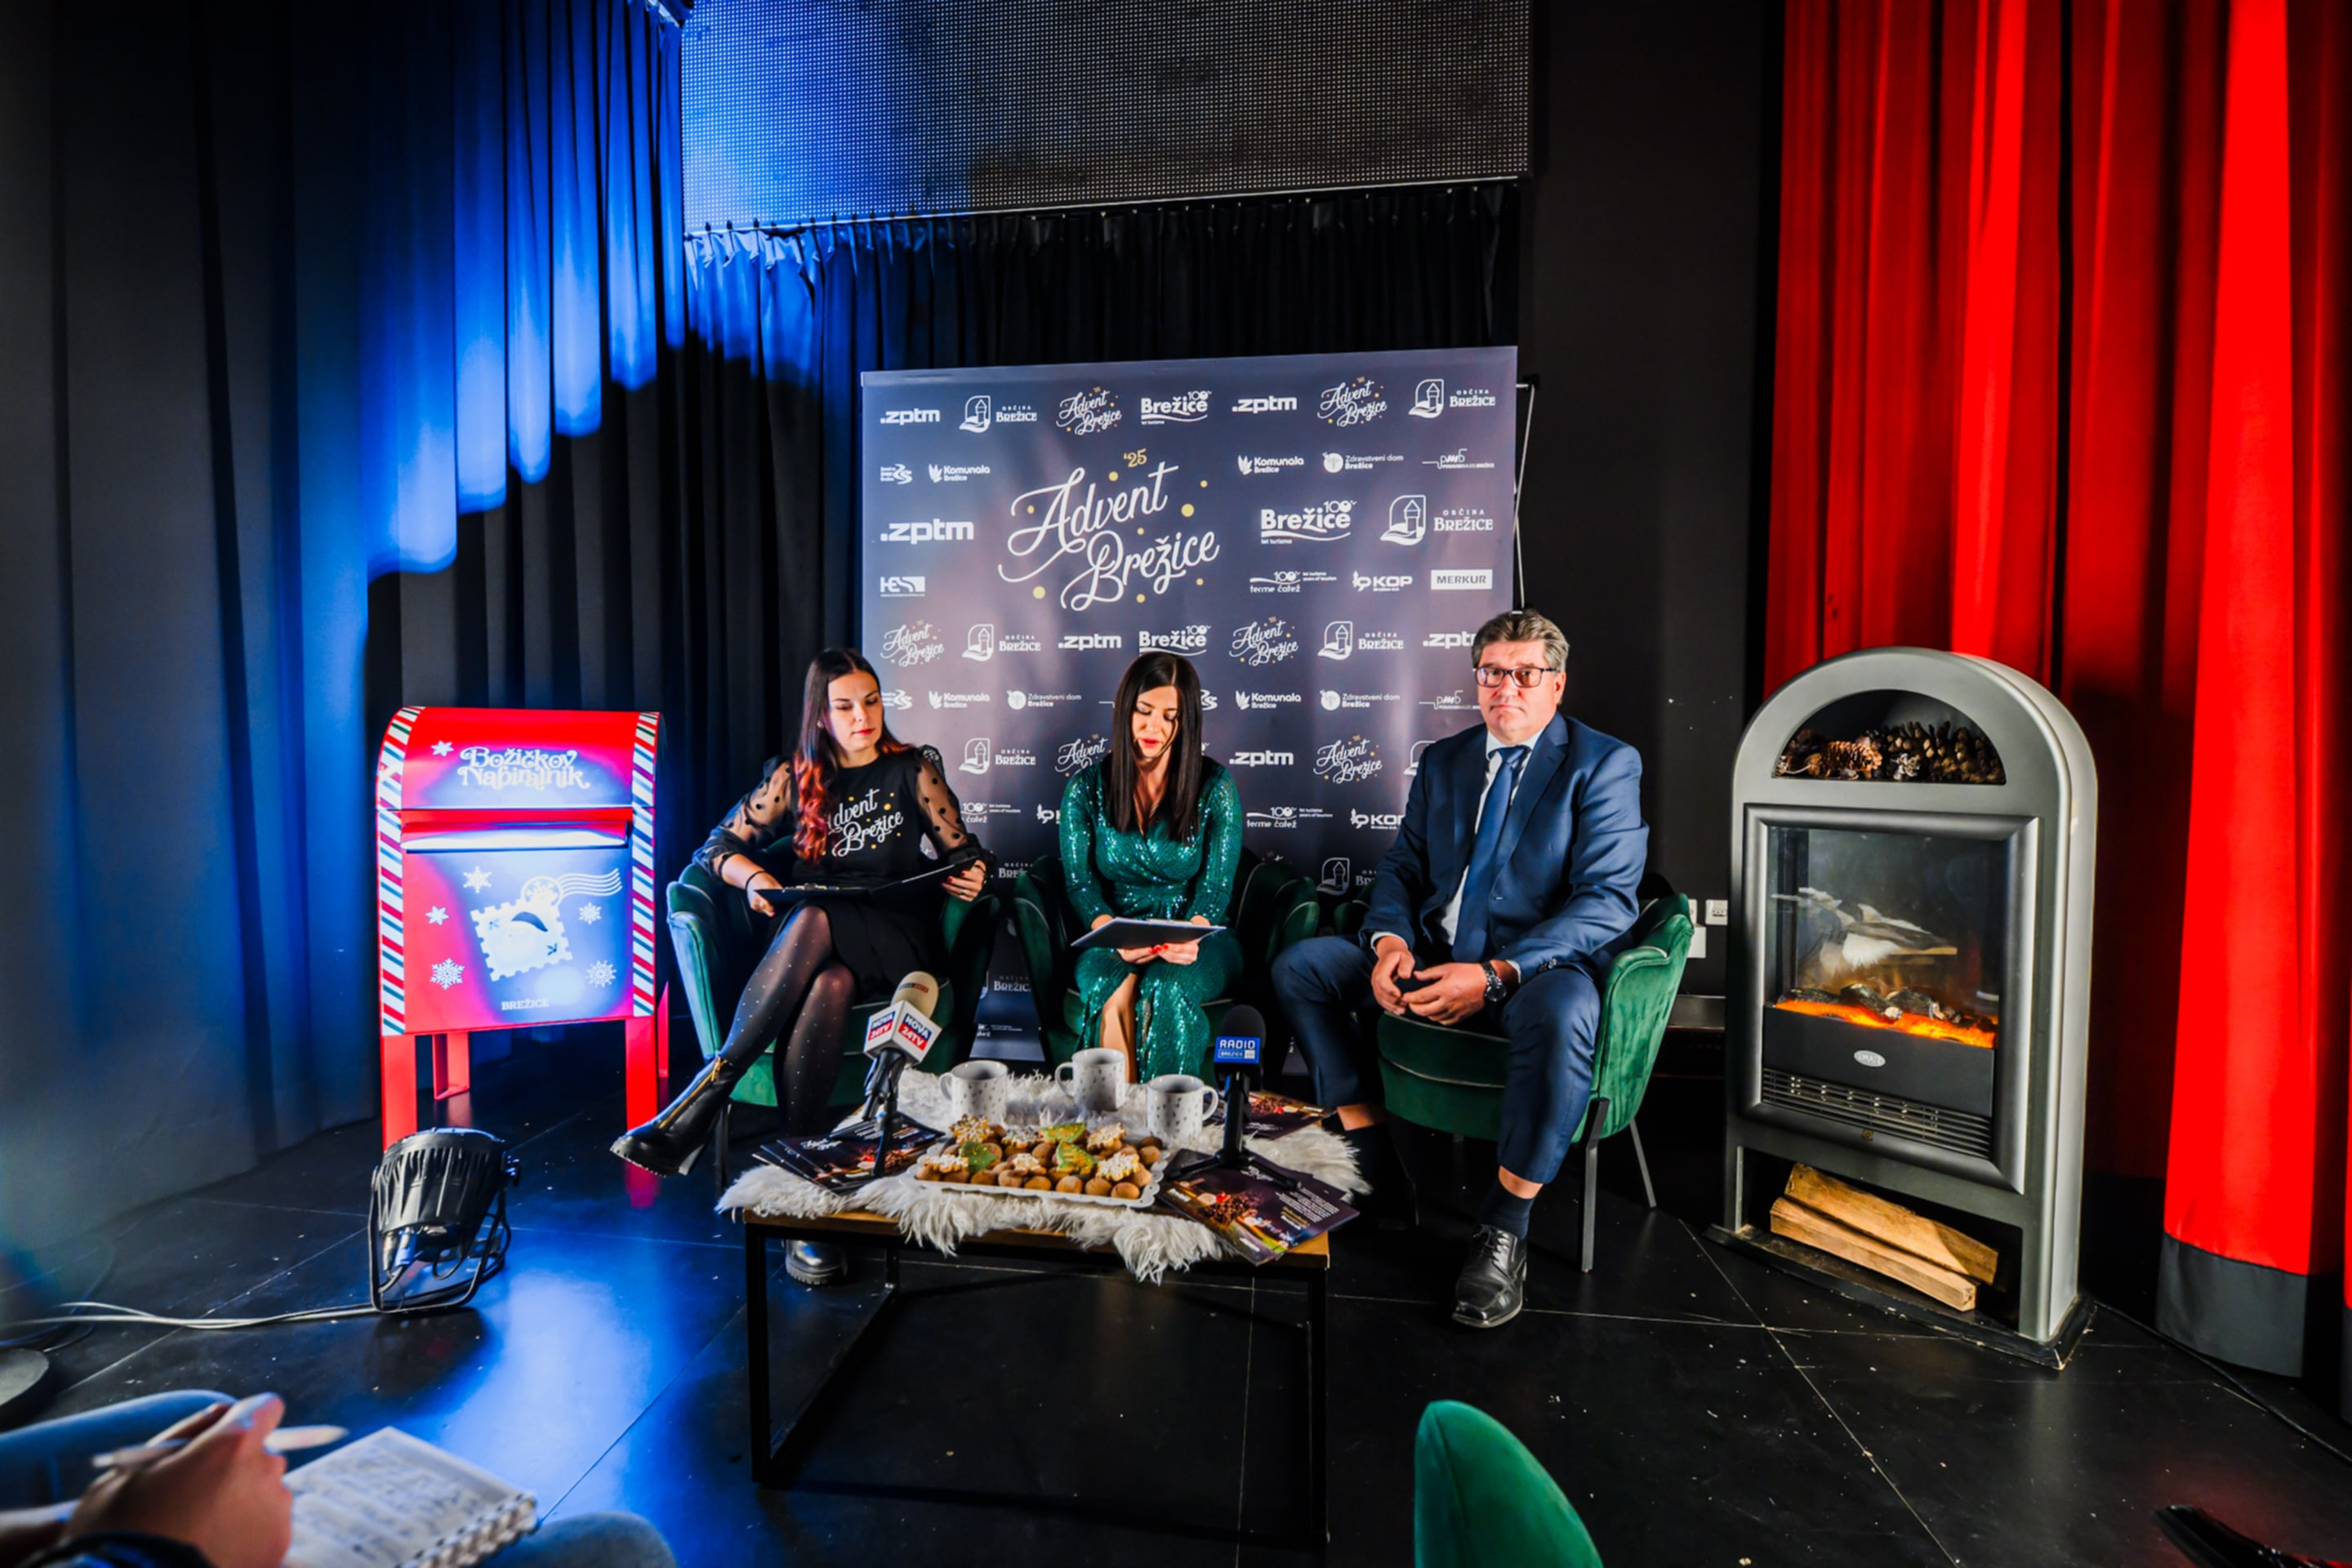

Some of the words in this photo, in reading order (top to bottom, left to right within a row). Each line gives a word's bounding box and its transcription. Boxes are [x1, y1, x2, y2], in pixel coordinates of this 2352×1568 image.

[1056, 390, 1111, 427] Advent
[1141, 396, 1208, 416] Brežice
[1232, 395, 1298, 414] .zptm
[1317, 380, 1375, 419] Advent
[1450, 394, 1496, 407] BREŽICE
[880, 408, 941, 425] .zptm
[1254, 456, 1304, 466] Komunala
[1387, 453, 1404, 461] dom
[943, 465, 991, 474] Komunala
[998, 461, 1178, 582] Advent
[1261, 507, 1352, 533] Brežice
[1433, 514, 1494, 532] BREŽICE
[880, 519, 974, 545] .zptm
[1061, 530, 1220, 611] Brežice
[1437, 575, 1486, 585] MERKUR
[1058, 634, 1122, 651] .zptm
[1138, 630, 1207, 650] Brežice
[1229, 620, 1287, 657] Advent
[1358, 638, 1404, 650] BREŽICE
[943, 693, 991, 702] Komunala
[1251, 693, 1301, 702] Komunala
[1383, 693, 1401, 702] dom
[460, 746, 578, 769] Božičkov
[1229, 751, 1294, 767] .zptm
[1313, 739, 1370, 775] Advent
[457, 766, 590, 791] Nabiralnik
[828, 788, 880, 835] dvent
[831, 812, 903, 857] Brežice
[994, 981, 1031, 991] BREŽIC
[501, 998, 550, 1011] BREŽICE
[902, 1026, 924, 1048] 24TV
[904, 1015, 929, 1040] NOVA
[1219, 1039, 1255, 1049] RADIO
